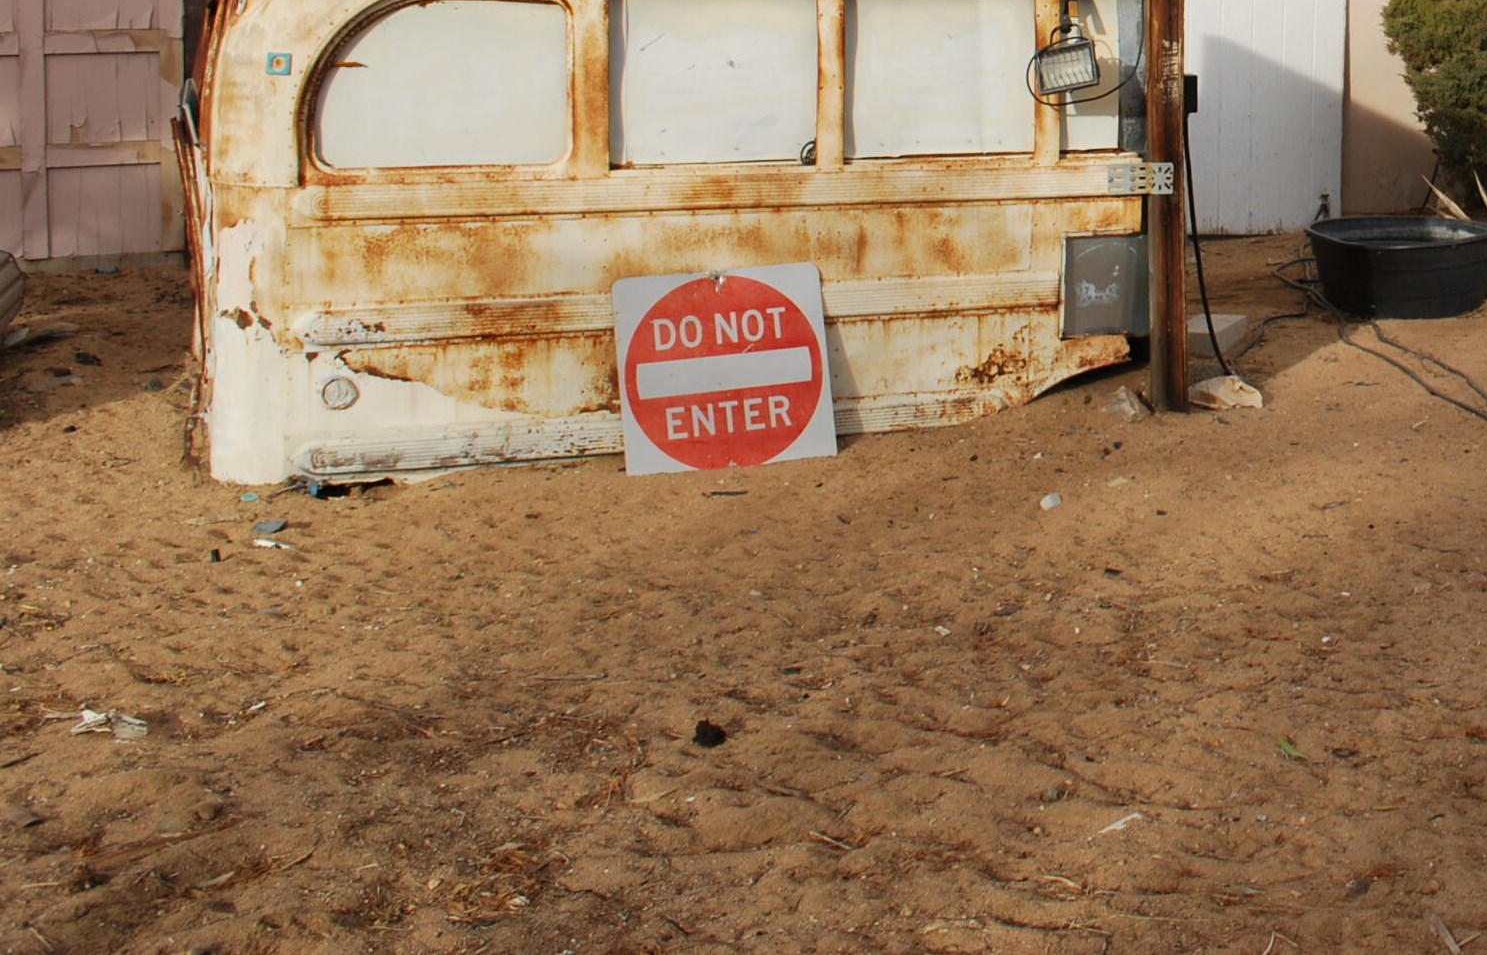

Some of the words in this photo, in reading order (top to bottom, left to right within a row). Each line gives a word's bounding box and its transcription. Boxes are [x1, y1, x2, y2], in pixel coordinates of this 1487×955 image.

[652, 314, 703, 352] DO
[714, 306, 786, 345] NOT
[665, 395, 792, 441] ENTER
